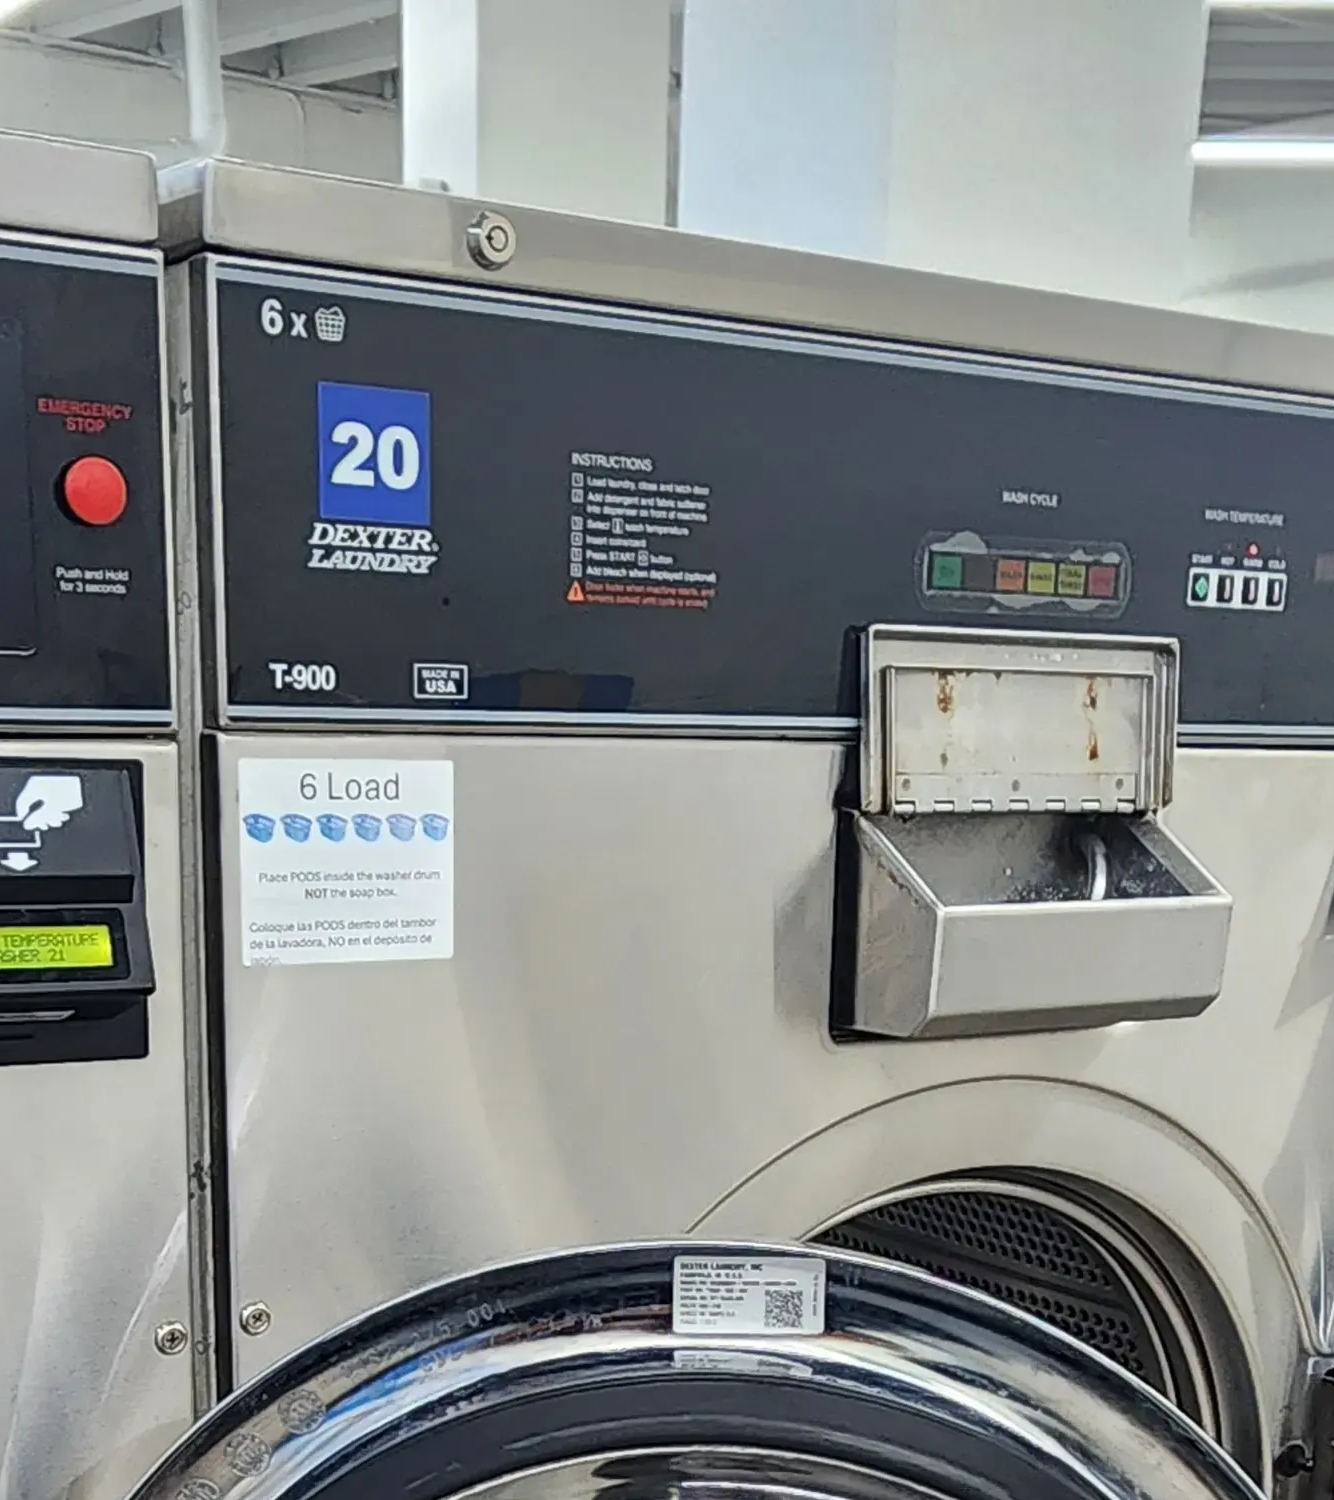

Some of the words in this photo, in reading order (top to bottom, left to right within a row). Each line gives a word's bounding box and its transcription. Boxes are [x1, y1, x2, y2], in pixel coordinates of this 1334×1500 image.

[260, 298, 283, 336] 6
[290, 311, 309, 339] x
[37, 398, 132, 420] EMERGENCY
[66, 417, 106, 433] STOP
[330, 419, 421, 490] 20
[571, 451, 653, 473] INSTRUCTIONS
[307, 521, 434, 552] DEXTER
[307, 548, 439, 574] LAUNDRY
[268, 662, 337, 691] T-900
[424, 679, 457, 694] USA
[299, 772, 318, 801] 6
[327, 771, 400, 801] Load
[258, 872, 288, 883] Place
[290, 871, 322, 882] PODS
[356, 871, 373, 881] the
[375, 870, 412, 881] washer
[413, 869, 441, 881] drum
[304, 887, 328, 900] NOT
[330, 888, 347, 899] the
[349, 888, 375, 899] soap
[314, 920, 346, 931] PODS
[382, 918, 399, 929] del
[1, 931, 100, 949] TEMPERATURE
[249, 939, 264, 950] de
[328, 936, 346, 947] NO
[46, 948, 66, 962] 21
